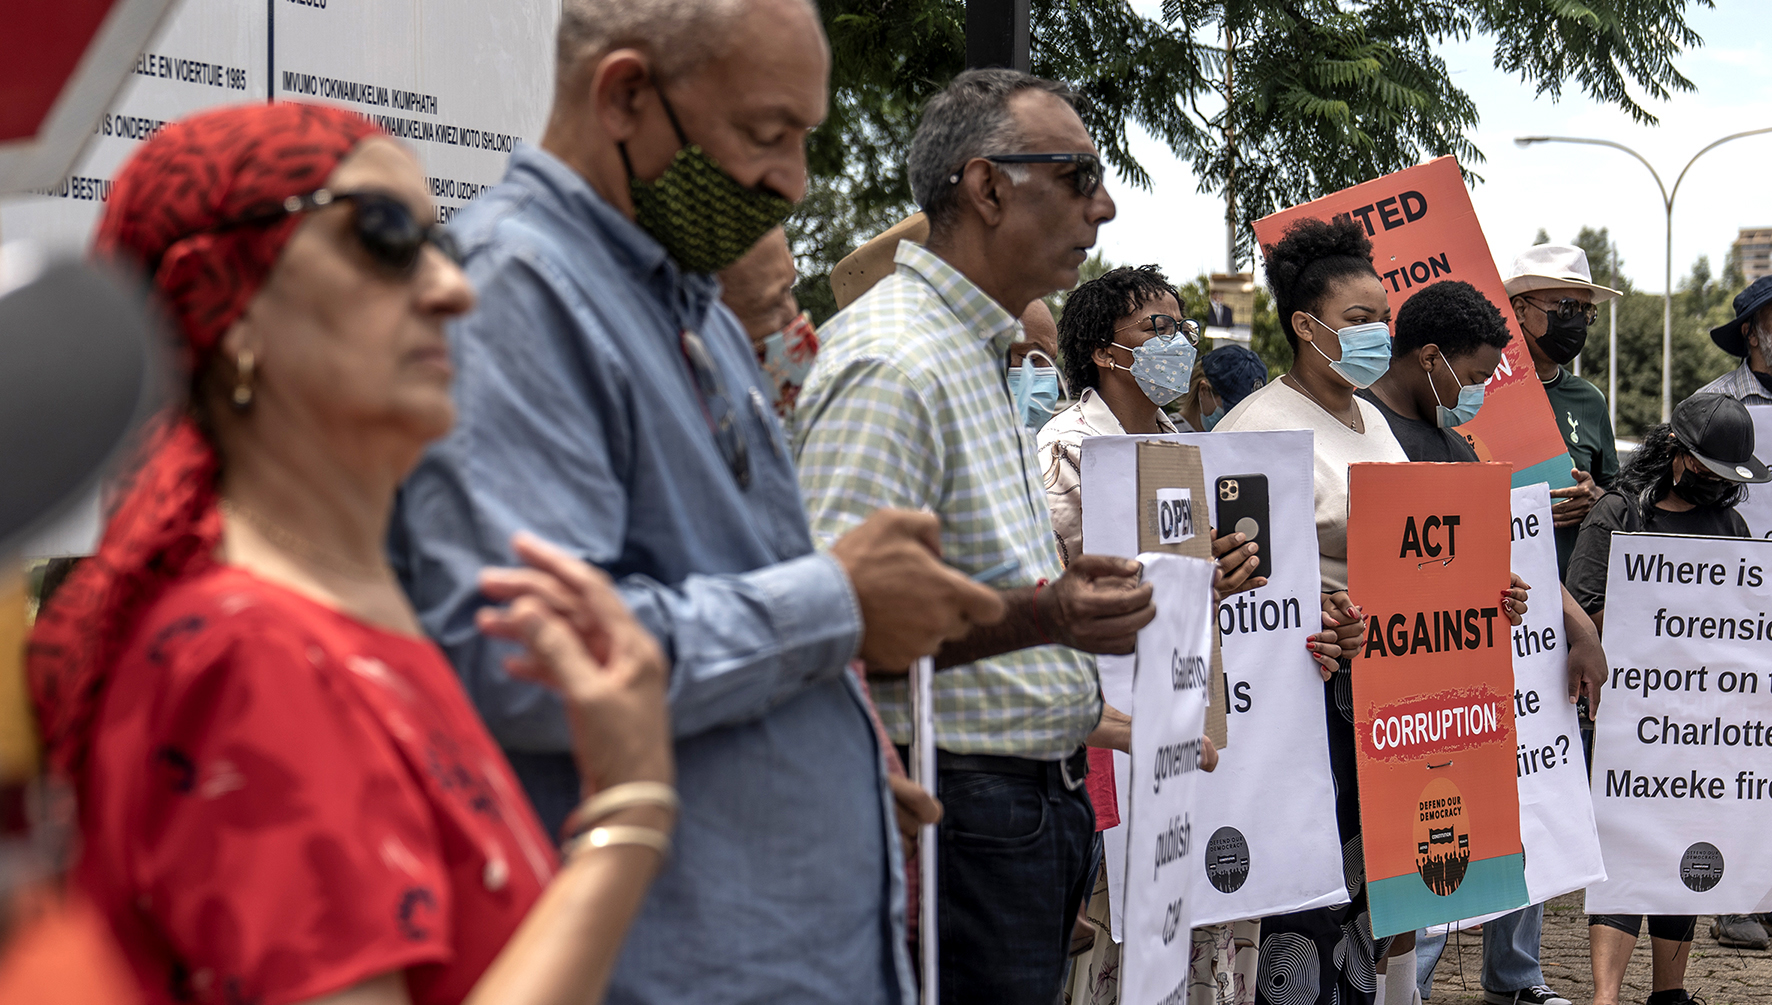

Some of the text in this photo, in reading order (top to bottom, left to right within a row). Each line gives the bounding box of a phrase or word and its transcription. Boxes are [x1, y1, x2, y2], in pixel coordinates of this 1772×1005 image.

[159, 56, 173, 79] EN
[174, 58, 223, 88] VOERTUIE
[225, 67, 247, 91] 1985
[282, 70, 317, 95] IMVUMO
[318, 75, 390, 107] YOKWAMUKELWA
[391, 89, 438, 115] IKUMPHATHI
[435, 123, 459, 145] KWEZI
[459, 128, 480, 149] MOTO
[481, 131, 512, 154] ISHLOKO
[422, 176, 455, 198] AMBAYO
[1332, 190, 1428, 237] TED
[1380, 252, 1452, 293] TION
[1161, 498, 1194, 539] OPEN
[1399, 515, 1461, 558] ACT
[1624, 553, 1763, 588] Where is
[1364, 607, 1498, 659] AGAINST
[1513, 625, 1556, 658] the
[1611, 666, 1708, 698] report
[1717, 670, 1758, 694] on
[1514, 689, 1540, 718] te
[1372, 702, 1497, 751] CORRUPTION
[1153, 737, 1201, 794] governme
[1605, 769, 1772, 800] Maxeke fir
[1420, 796, 1461, 811] DEFEND OUR
[1420, 807, 1461, 821] DEMOCRACY
[1153, 811, 1191, 881] publish
[1210, 838, 1231, 846] DEFEND
[1210, 843, 1242, 852] DEMOCRACY
